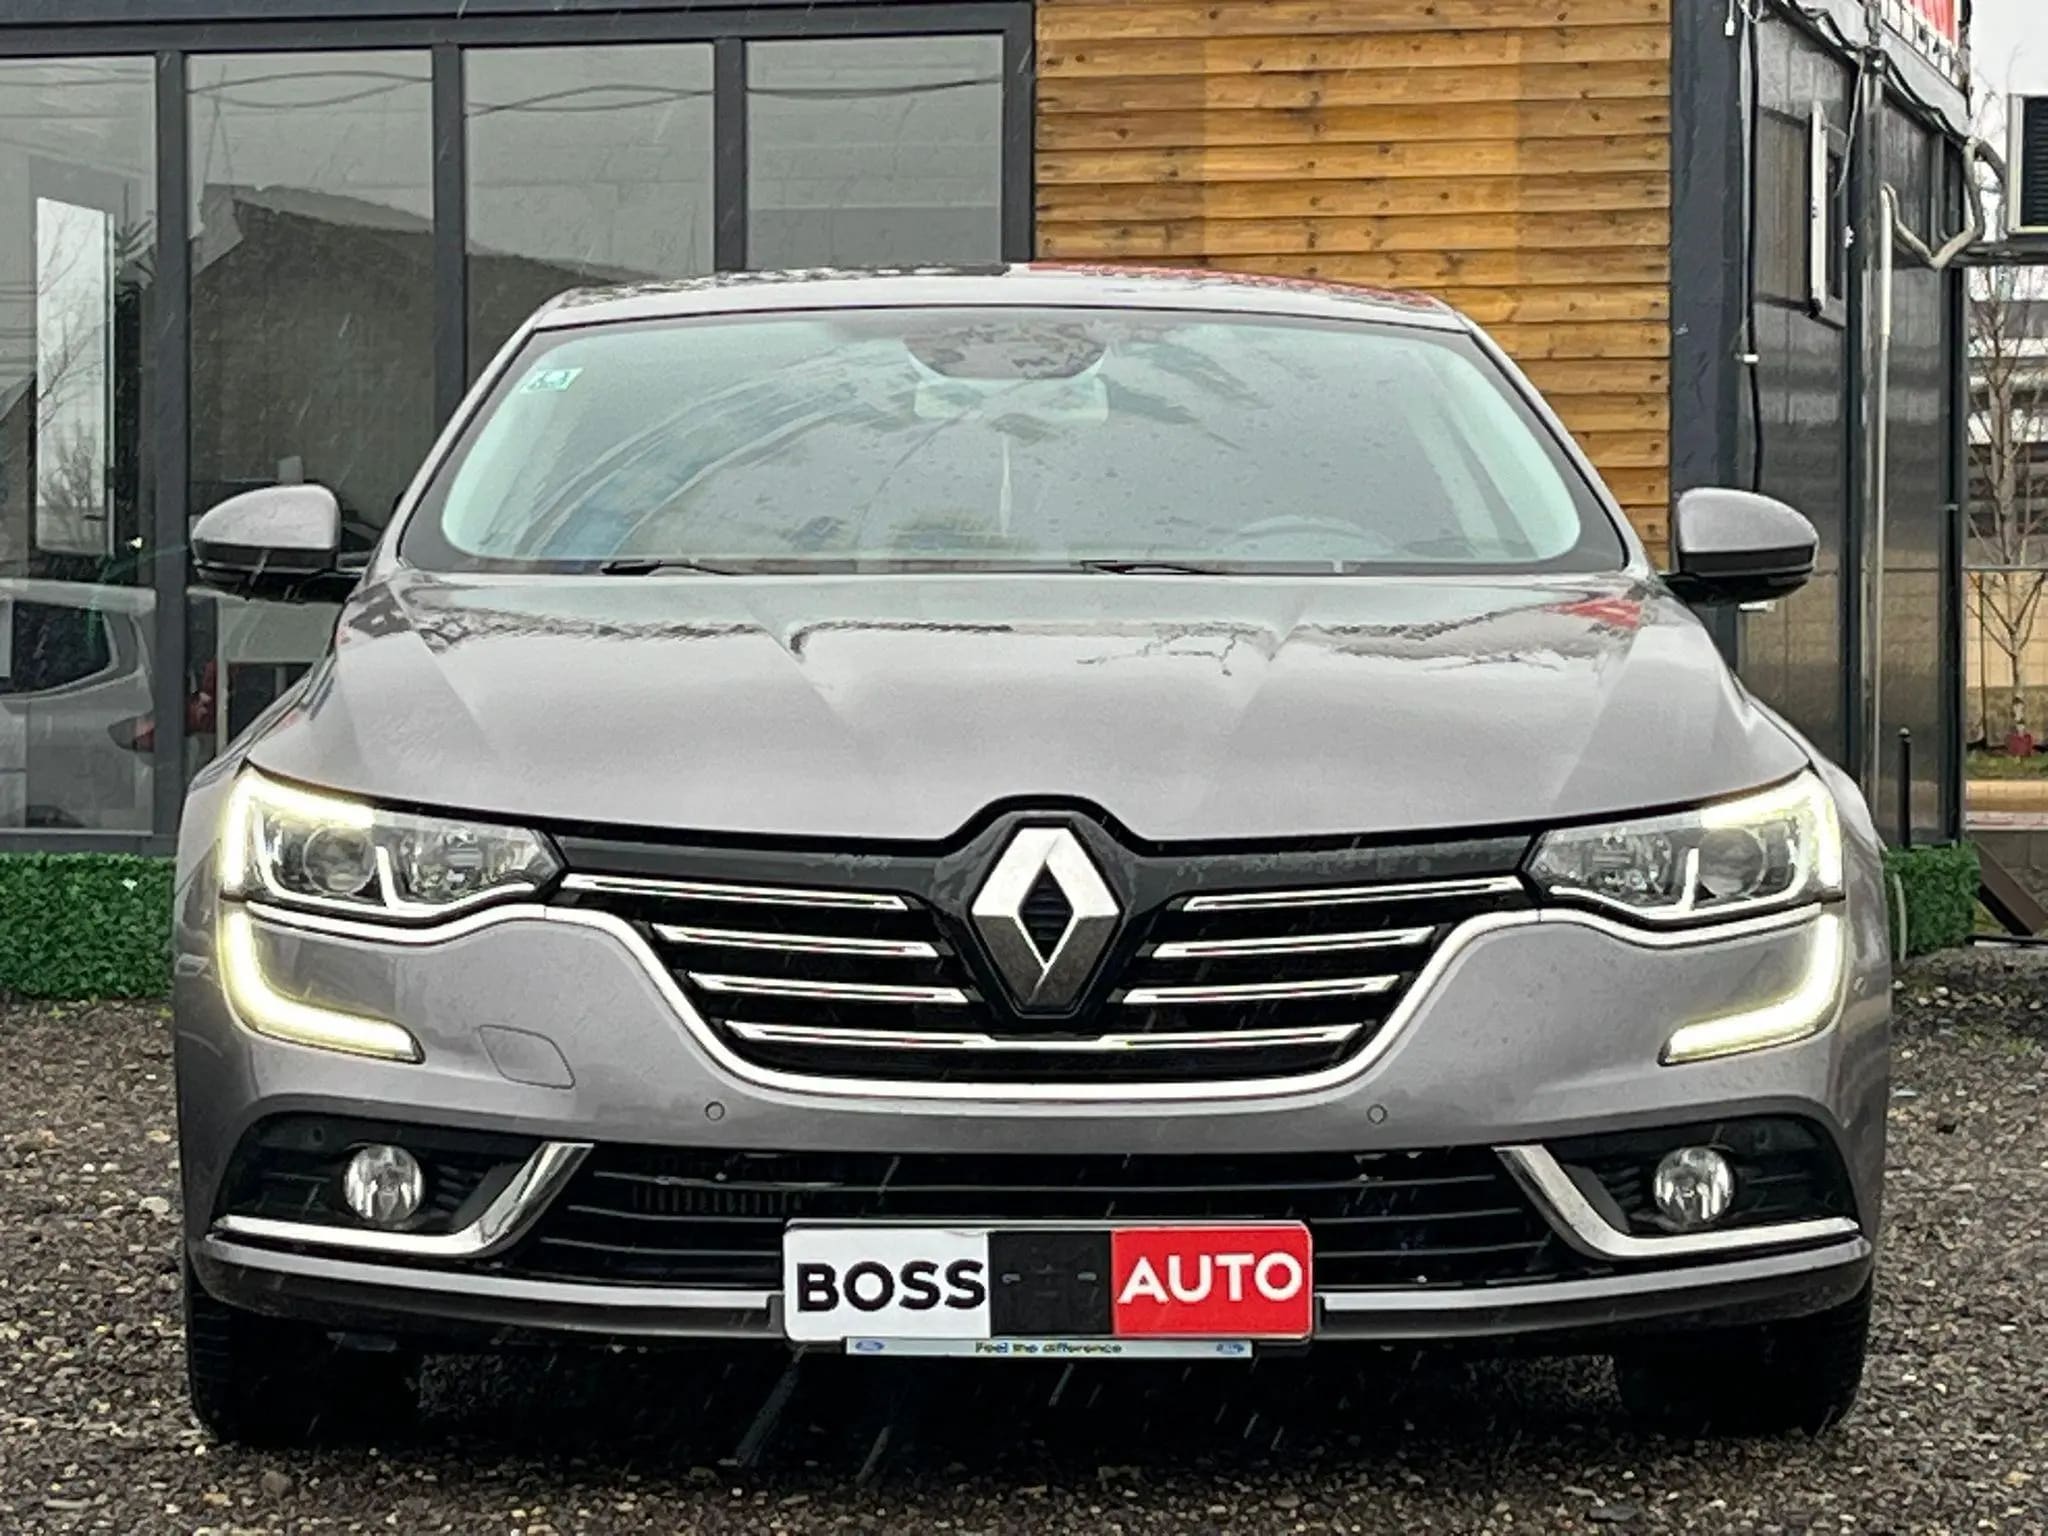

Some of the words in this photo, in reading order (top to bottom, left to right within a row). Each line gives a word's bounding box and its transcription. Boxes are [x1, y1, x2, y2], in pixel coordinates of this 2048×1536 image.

[797, 1259, 986, 1312] BOSS
[1117, 1252, 1303, 1304] AUTO
[975, 1341, 1008, 1353] Feel
[1013, 1342, 1039, 1353] the
[1042, 1342, 1122, 1353] difference
